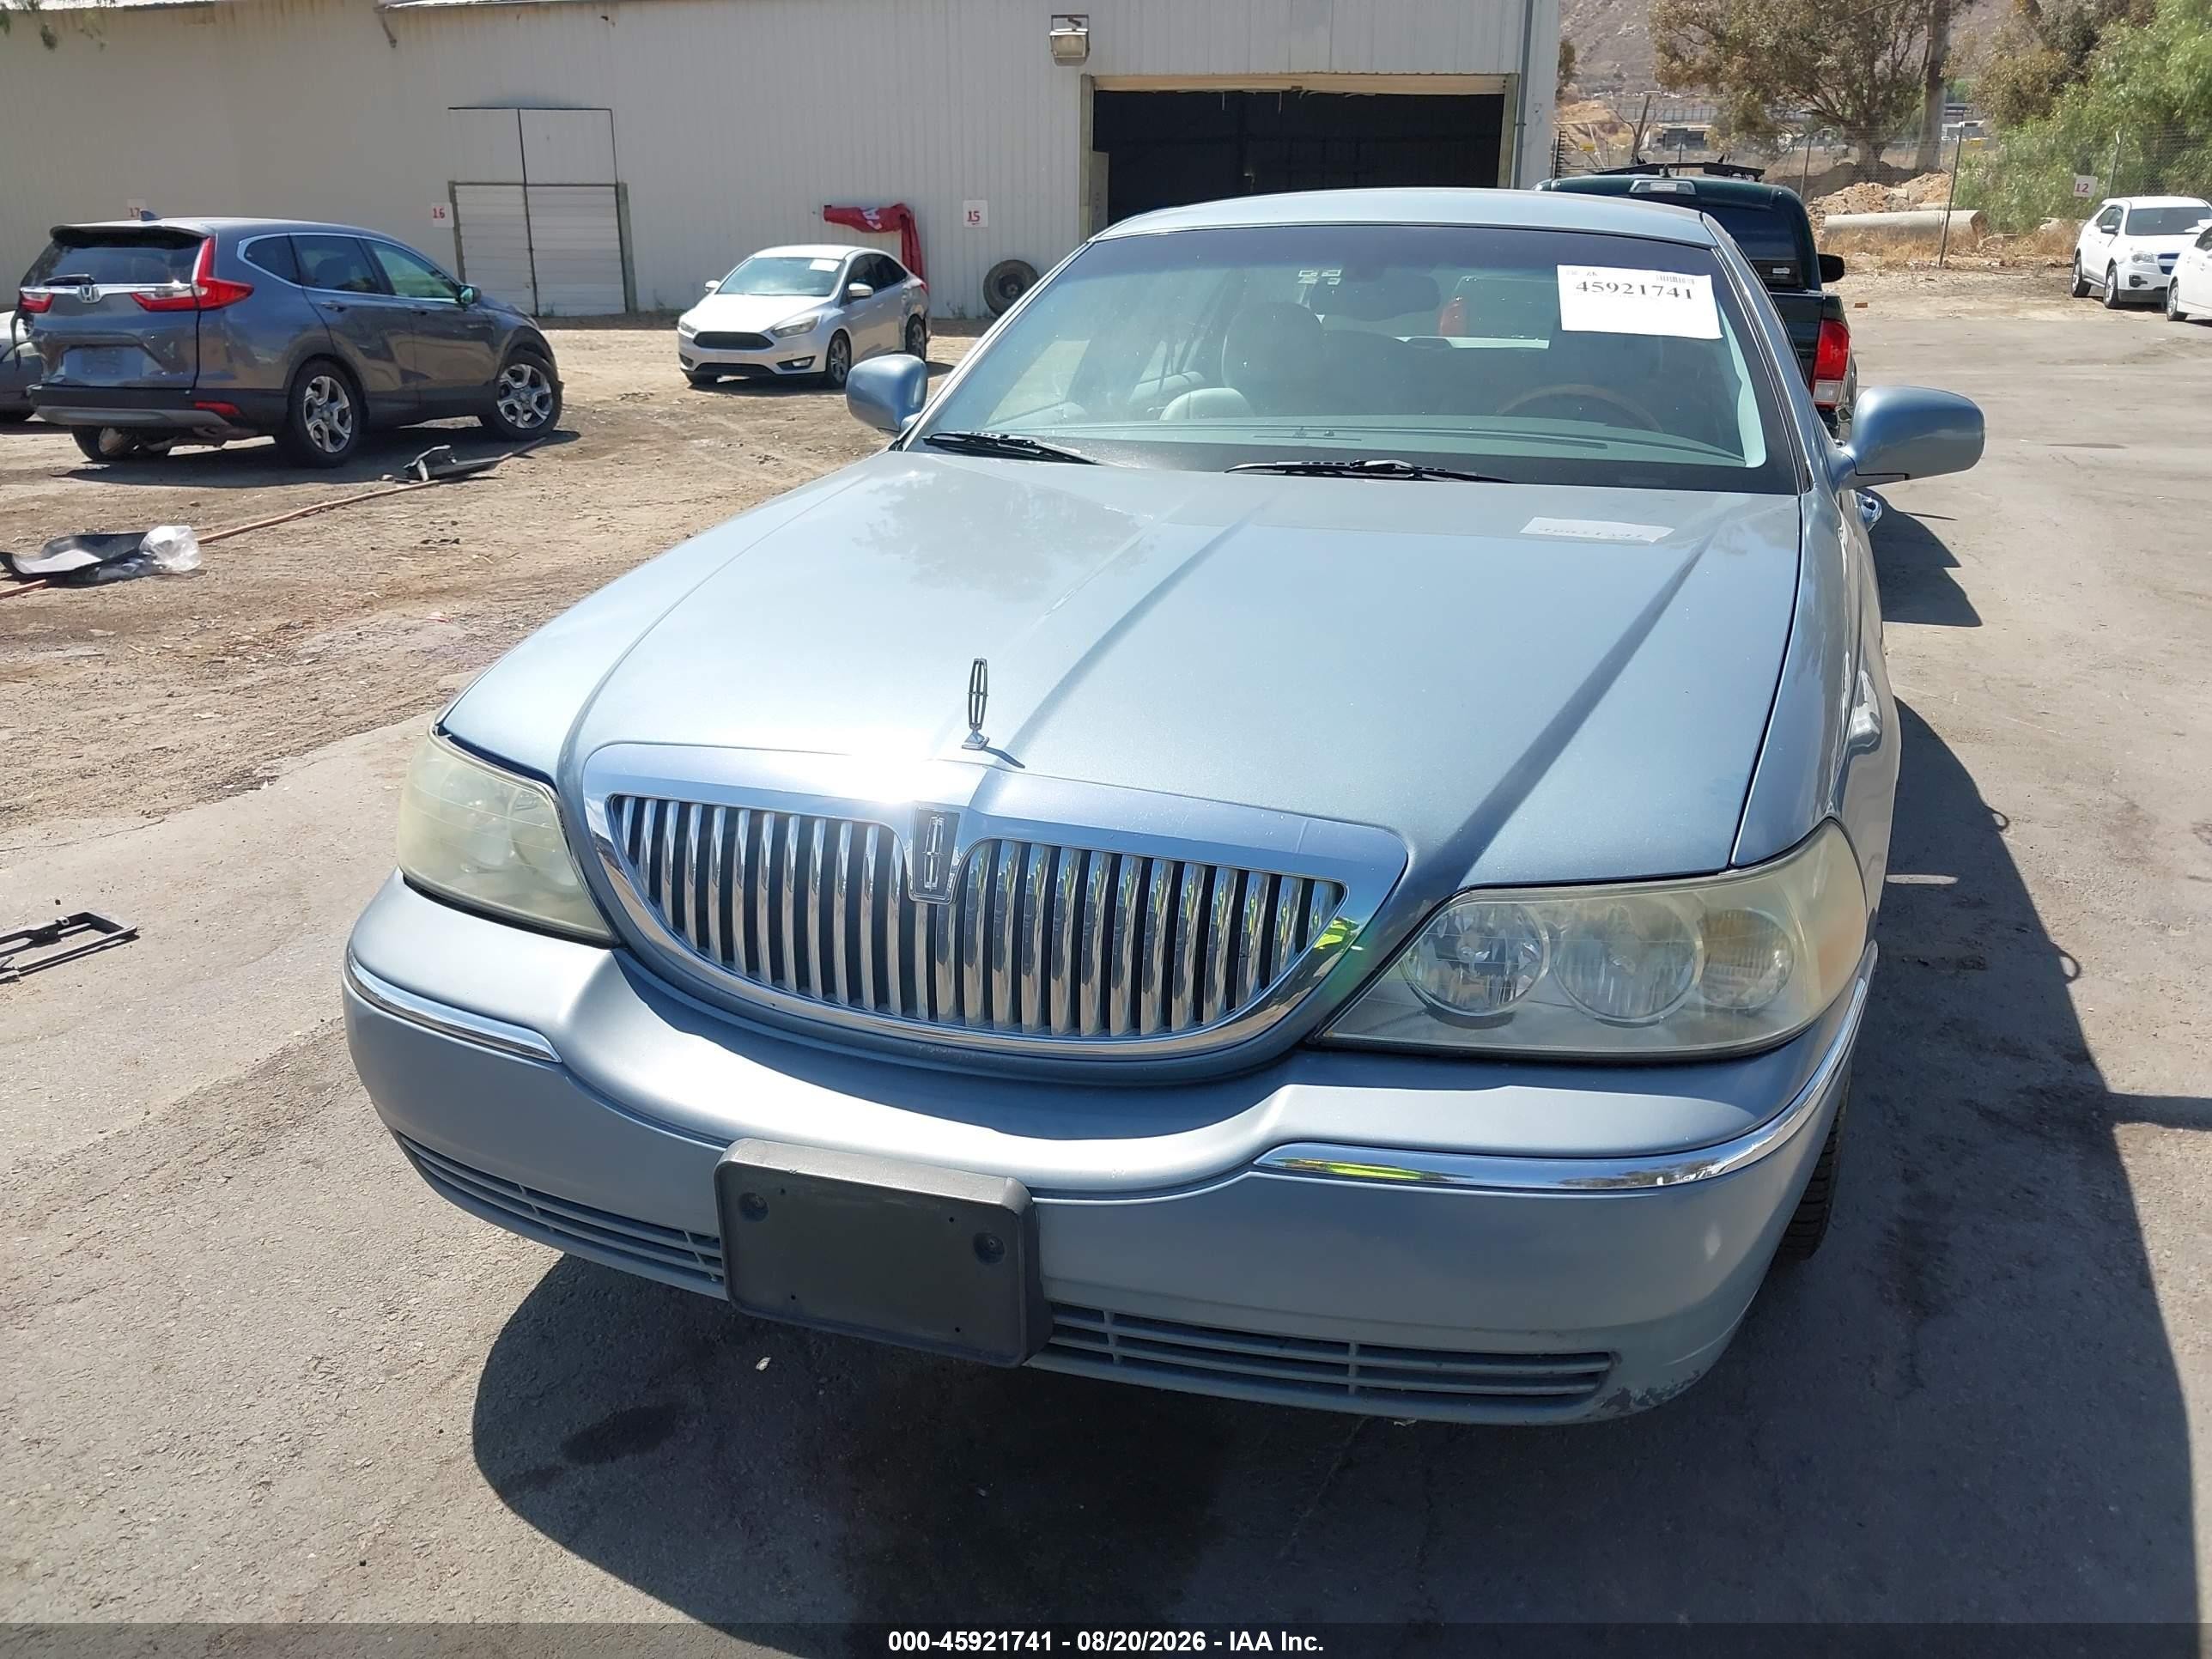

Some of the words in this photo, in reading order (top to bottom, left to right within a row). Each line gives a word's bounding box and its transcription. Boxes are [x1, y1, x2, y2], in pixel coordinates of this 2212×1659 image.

[2075, 183, 2089, 193] 12
[433, 207, 446, 219] 16
[968, 210, 981, 222] 15
[1576, 281, 1692, 300] 45921741
